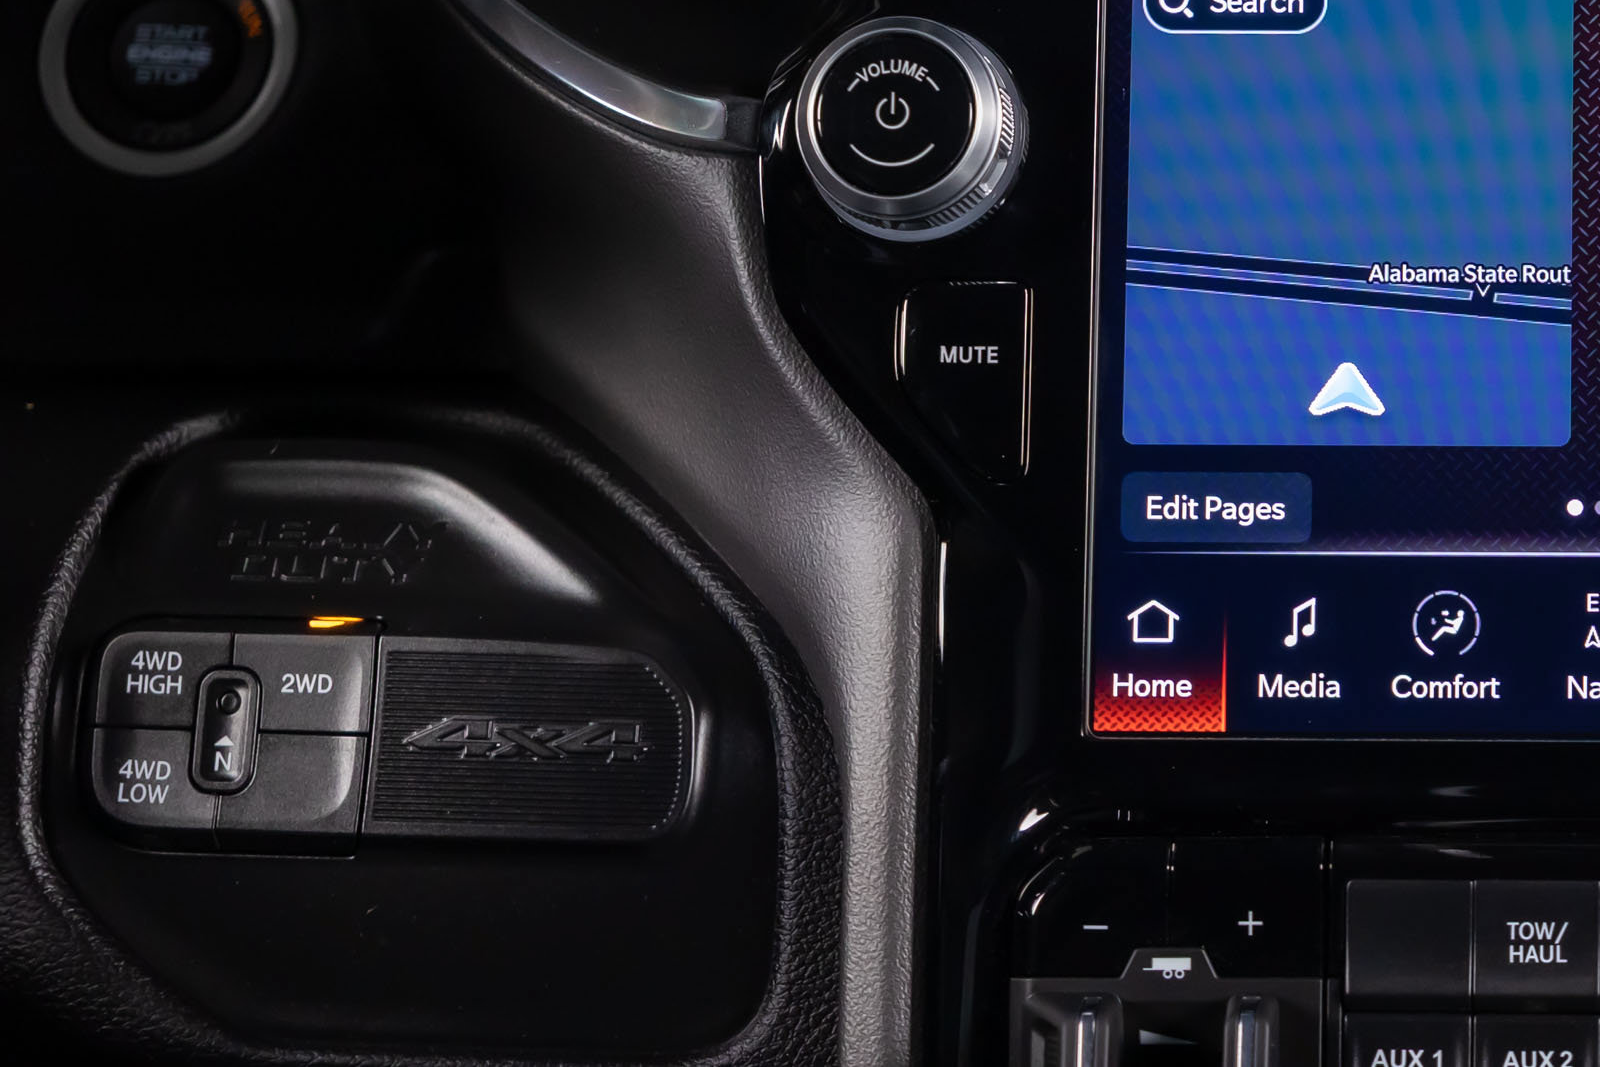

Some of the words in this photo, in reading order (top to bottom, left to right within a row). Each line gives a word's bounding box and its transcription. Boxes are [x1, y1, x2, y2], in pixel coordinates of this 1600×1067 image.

[855, 59, 930, 82] VOLUME
[1367, 263, 1460, 283] Alabama
[1464, 264, 1518, 284] State
[1523, 265, 1571, 284] Rout
[939, 345, 999, 364] MUTE
[1146, 494, 1199, 520] Edit
[1205, 495, 1286, 527] Pages
[1586, 592, 1600, 613] E
[131, 650, 183, 671] 4WD
[126, 673, 183, 695] HIGH
[280, 673, 333, 694] 2WD
[1112, 672, 1193, 698] Home
[1258, 672, 1341, 699] Media
[1391, 673, 1501, 699] Comfort
[401, 714, 652, 763] 4x4
[118, 758, 172, 781] 4WD
[214, 750, 233, 773] N
[117, 782, 170, 805] LOW
[1506, 921, 1569, 945] TOW/
[1509, 944, 1568, 964] HAUL
[1371, 1048, 1425, 1067] AUX
[1432, 1049, 1443, 1067] 1
[1502, 1050, 1555, 1067] AUX
[1559, 1050, 1573, 1067] 2
